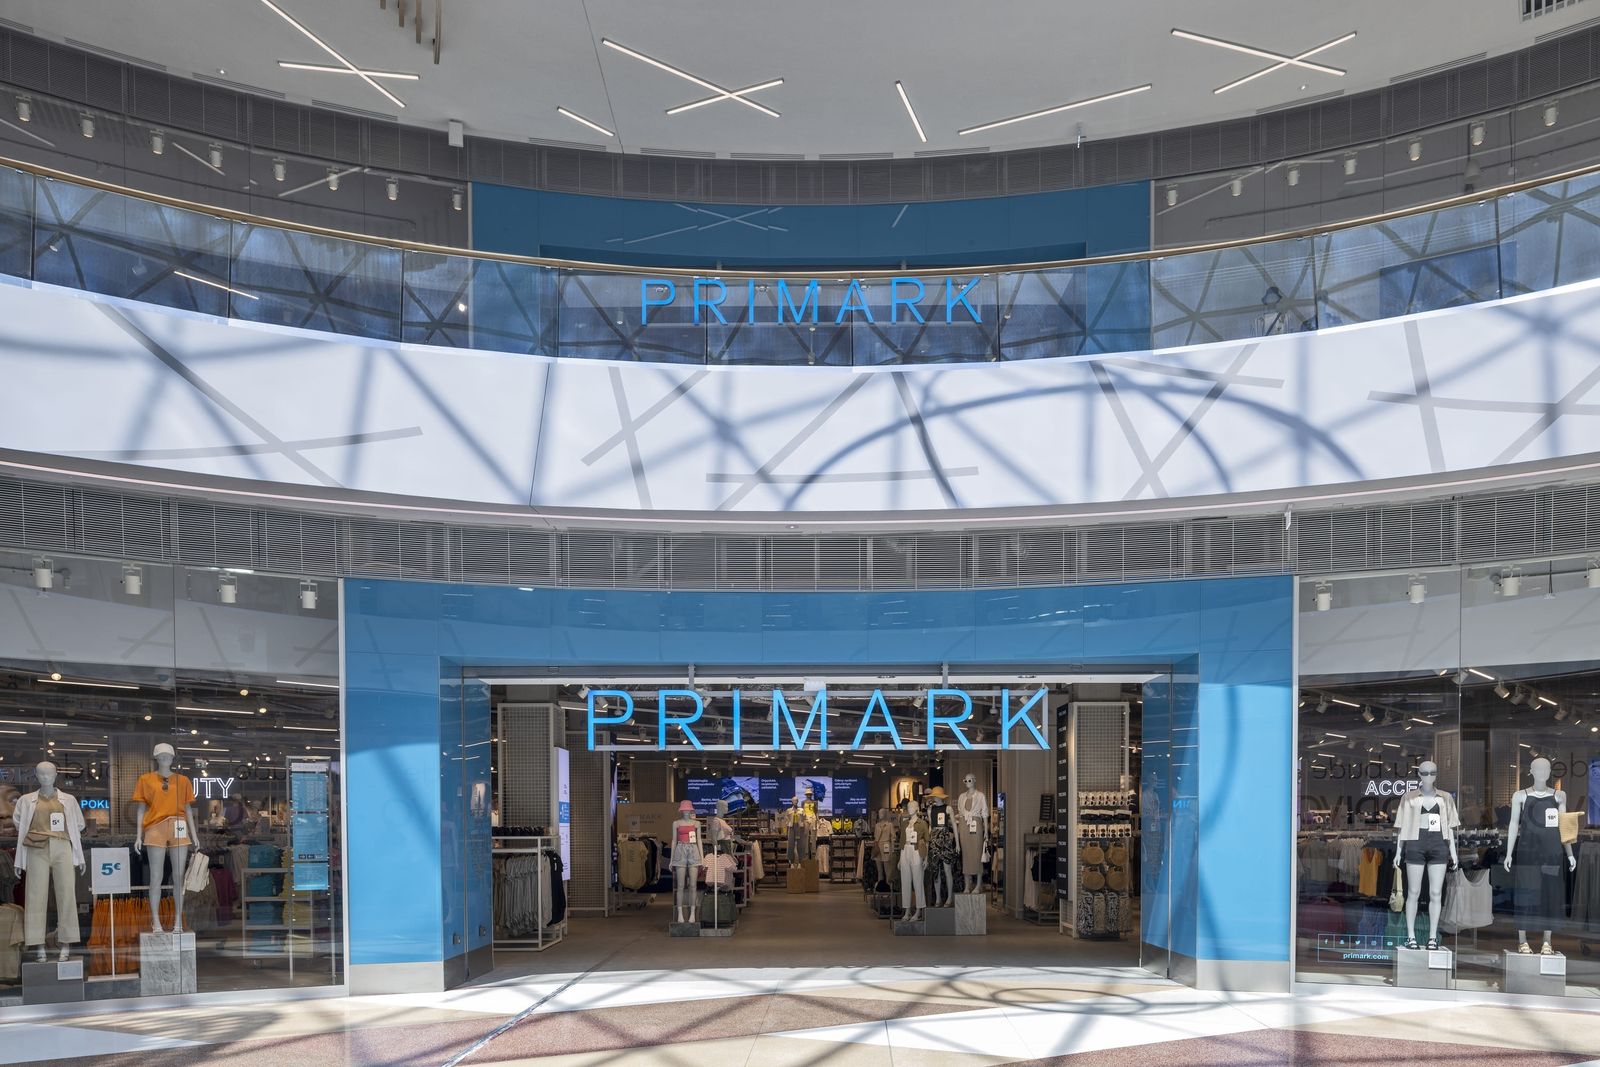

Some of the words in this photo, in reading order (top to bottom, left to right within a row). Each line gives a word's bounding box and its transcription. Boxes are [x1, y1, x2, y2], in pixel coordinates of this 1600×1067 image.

[640, 277, 983, 326] PRIMARK
[587, 689, 1051, 752] PRIMARK
[1365, 780, 1424, 796] ACCE
[101, 862, 121, 876] 5€
[1343, 953, 1389, 961] primark.com
